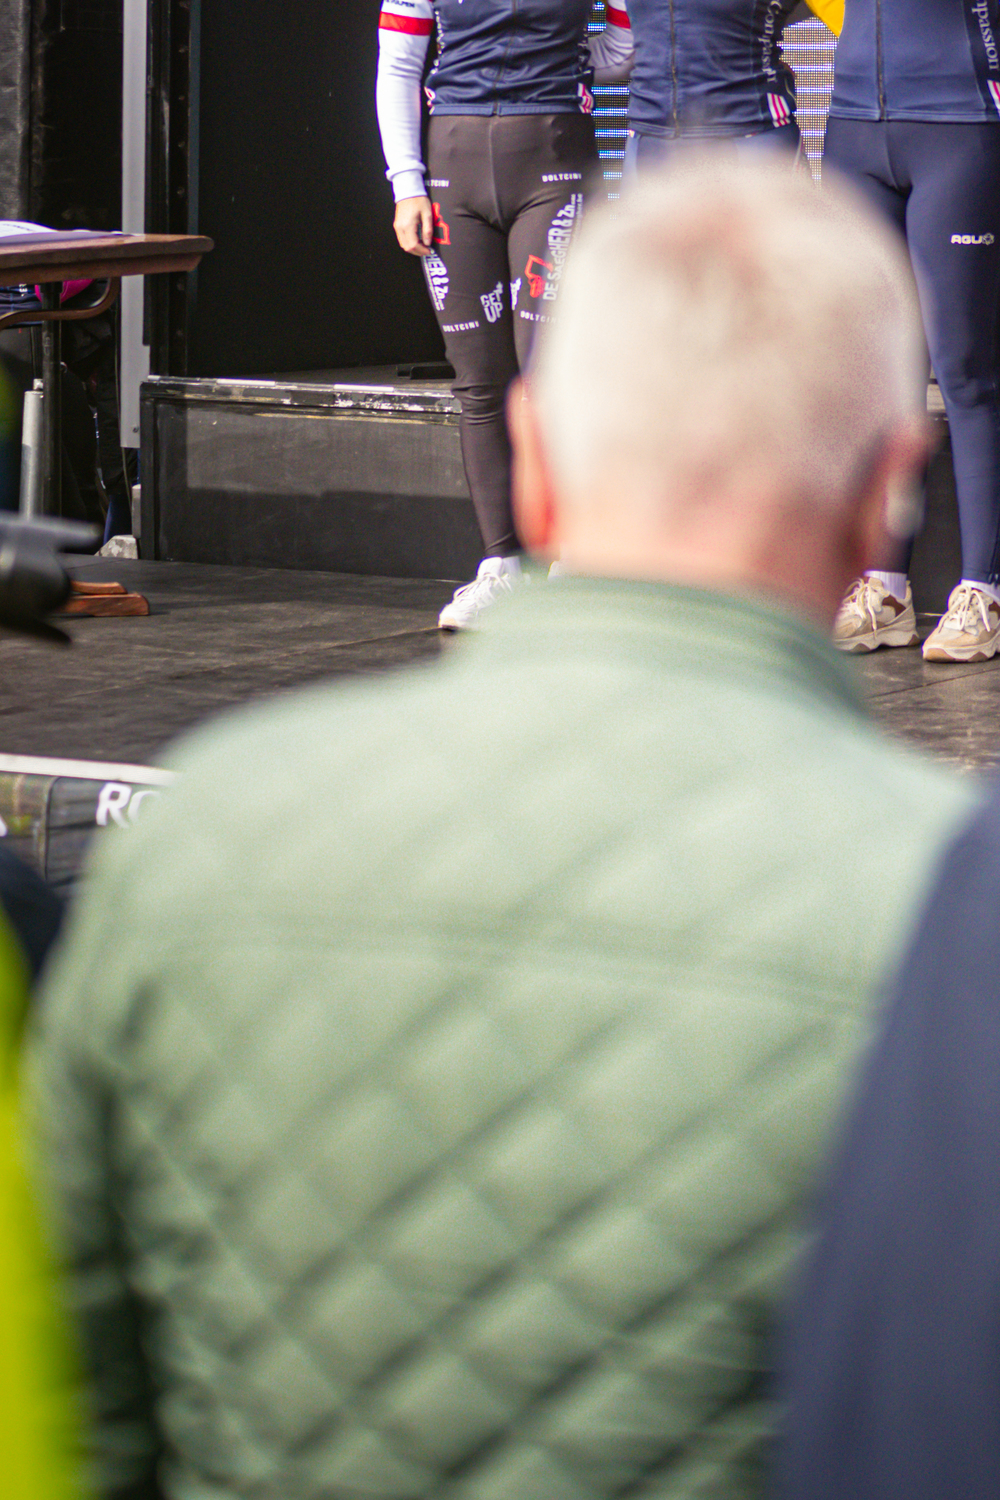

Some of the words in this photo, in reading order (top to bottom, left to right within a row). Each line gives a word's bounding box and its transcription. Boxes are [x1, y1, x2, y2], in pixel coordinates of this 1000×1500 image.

[951, 235, 983, 245] AGU
[547, 226, 573, 281] SAEGHER
[542, 284, 559, 301] DE
